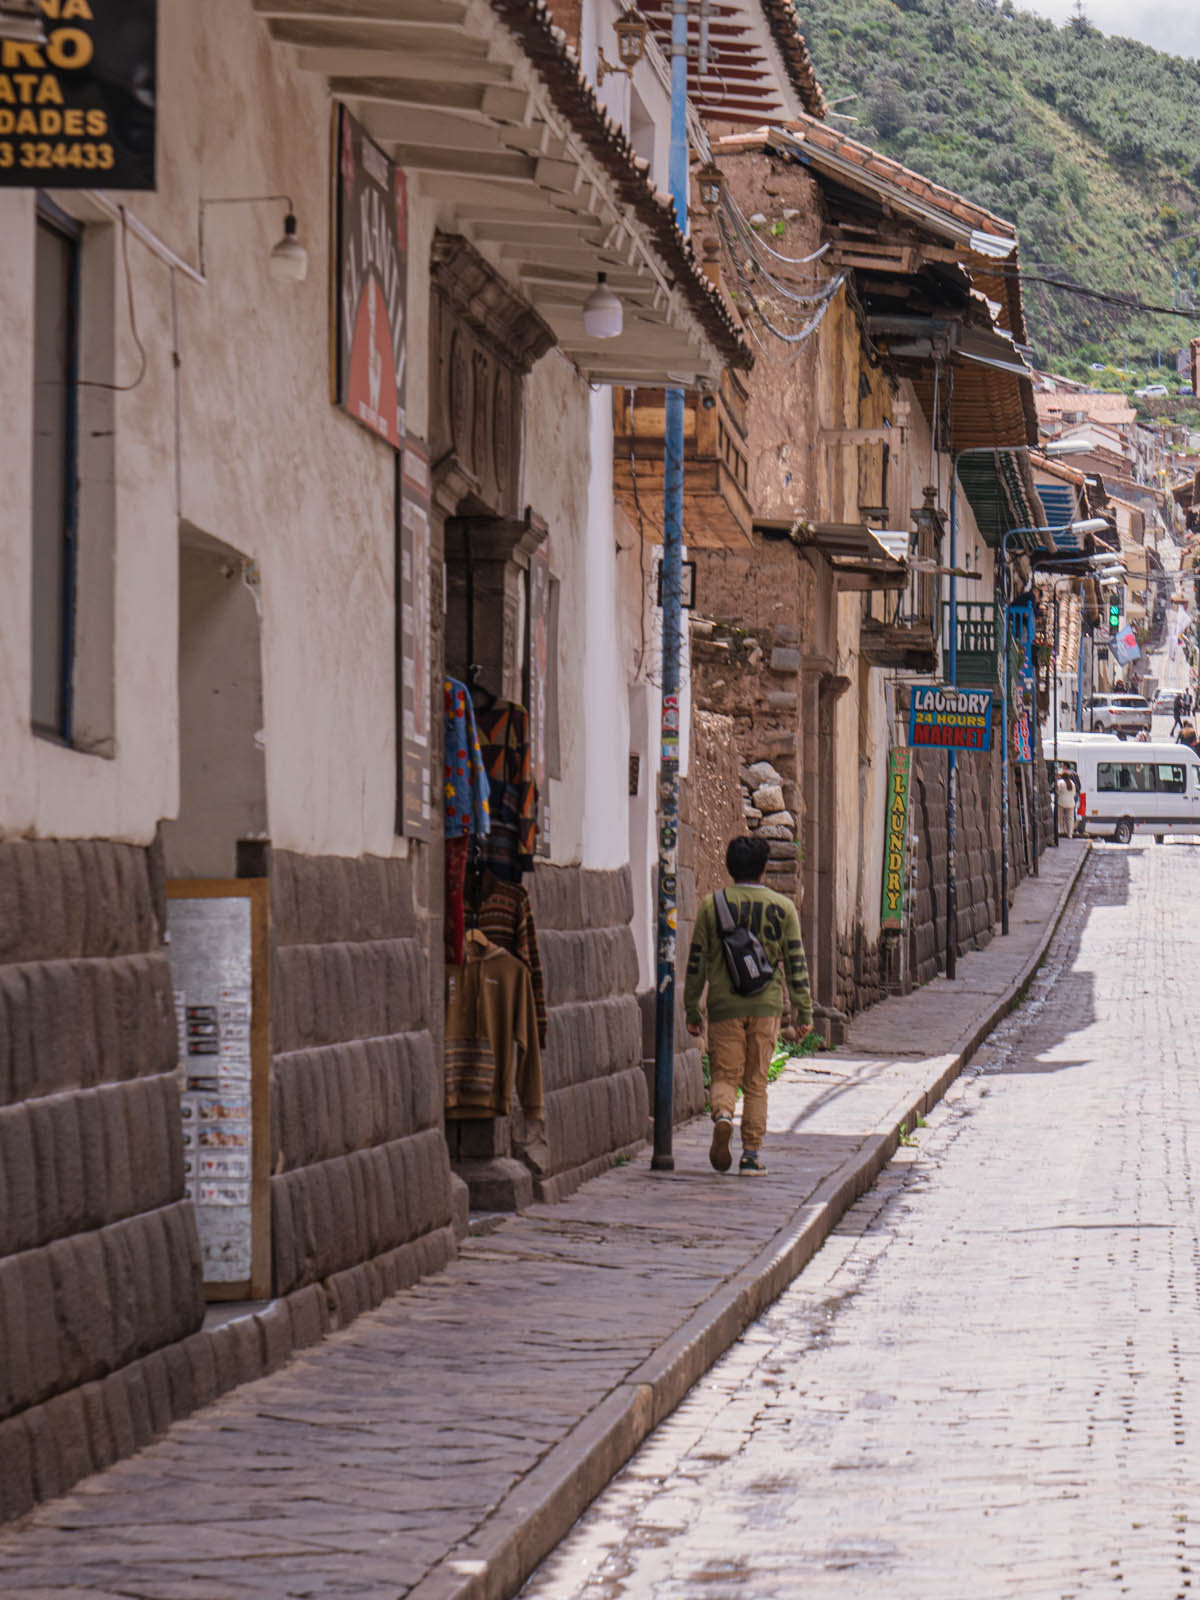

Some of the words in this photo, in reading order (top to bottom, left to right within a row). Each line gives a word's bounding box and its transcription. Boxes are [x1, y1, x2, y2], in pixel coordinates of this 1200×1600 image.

[20, 142, 115, 169] 324433
[914, 690, 990, 714] LAUNDRY
[915, 713, 933, 723] 24
[936, 713, 986, 727] HOURS
[914, 725, 986, 748] MARKET
[887, 774, 906, 910] LAUNDRY
